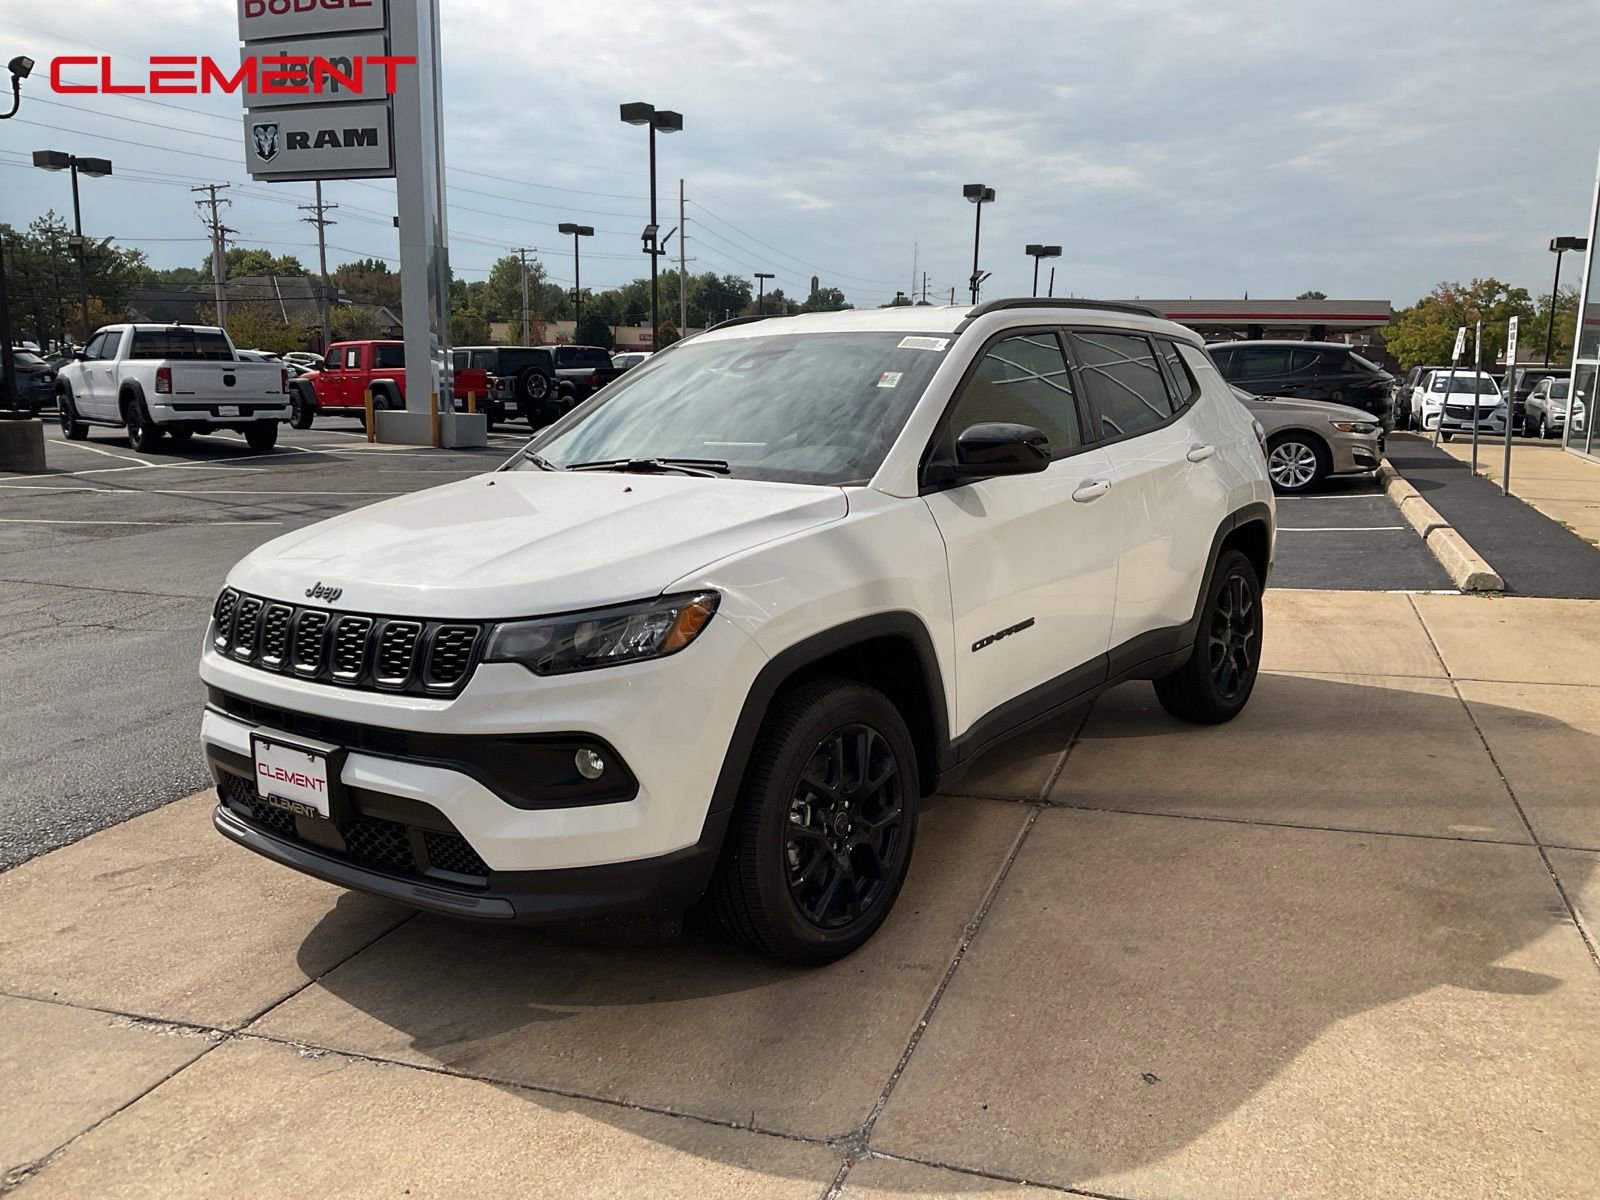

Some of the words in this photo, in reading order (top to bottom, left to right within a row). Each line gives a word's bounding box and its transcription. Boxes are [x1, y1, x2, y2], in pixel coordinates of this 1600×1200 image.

[286, 128, 378, 150] RAM
[305, 581, 343, 604] Jeep
[971, 617, 1035, 653] COMPASS
[258, 762, 325, 792] CLEMENT
[268, 795, 316, 819] CLEMENT
